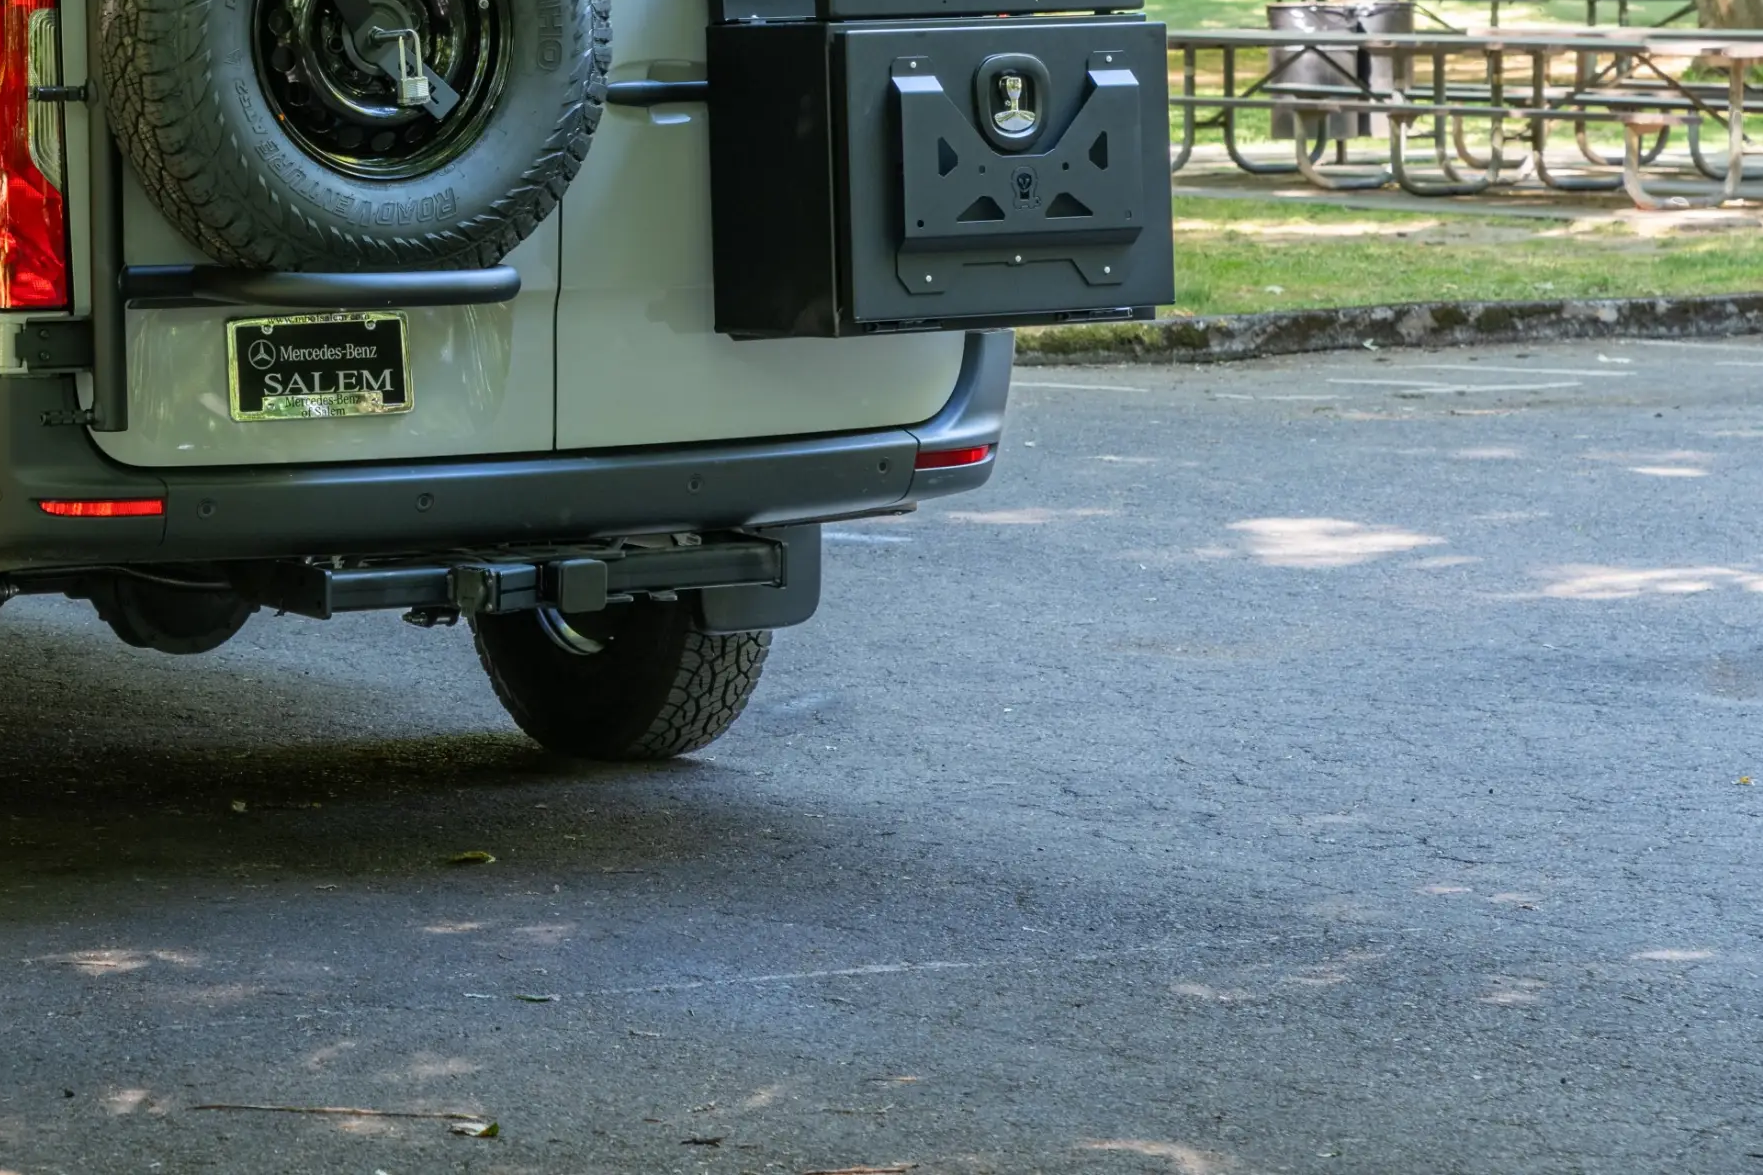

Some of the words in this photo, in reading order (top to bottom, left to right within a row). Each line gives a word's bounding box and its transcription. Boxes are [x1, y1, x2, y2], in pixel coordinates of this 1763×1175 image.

[280, 343, 377, 362] Mercedes-Benz
[264, 368, 394, 396] SALEM
[285, 393, 361, 408] Mercedes-Benz
[301, 407, 312, 417] of
[314, 406, 346, 417] Salem
